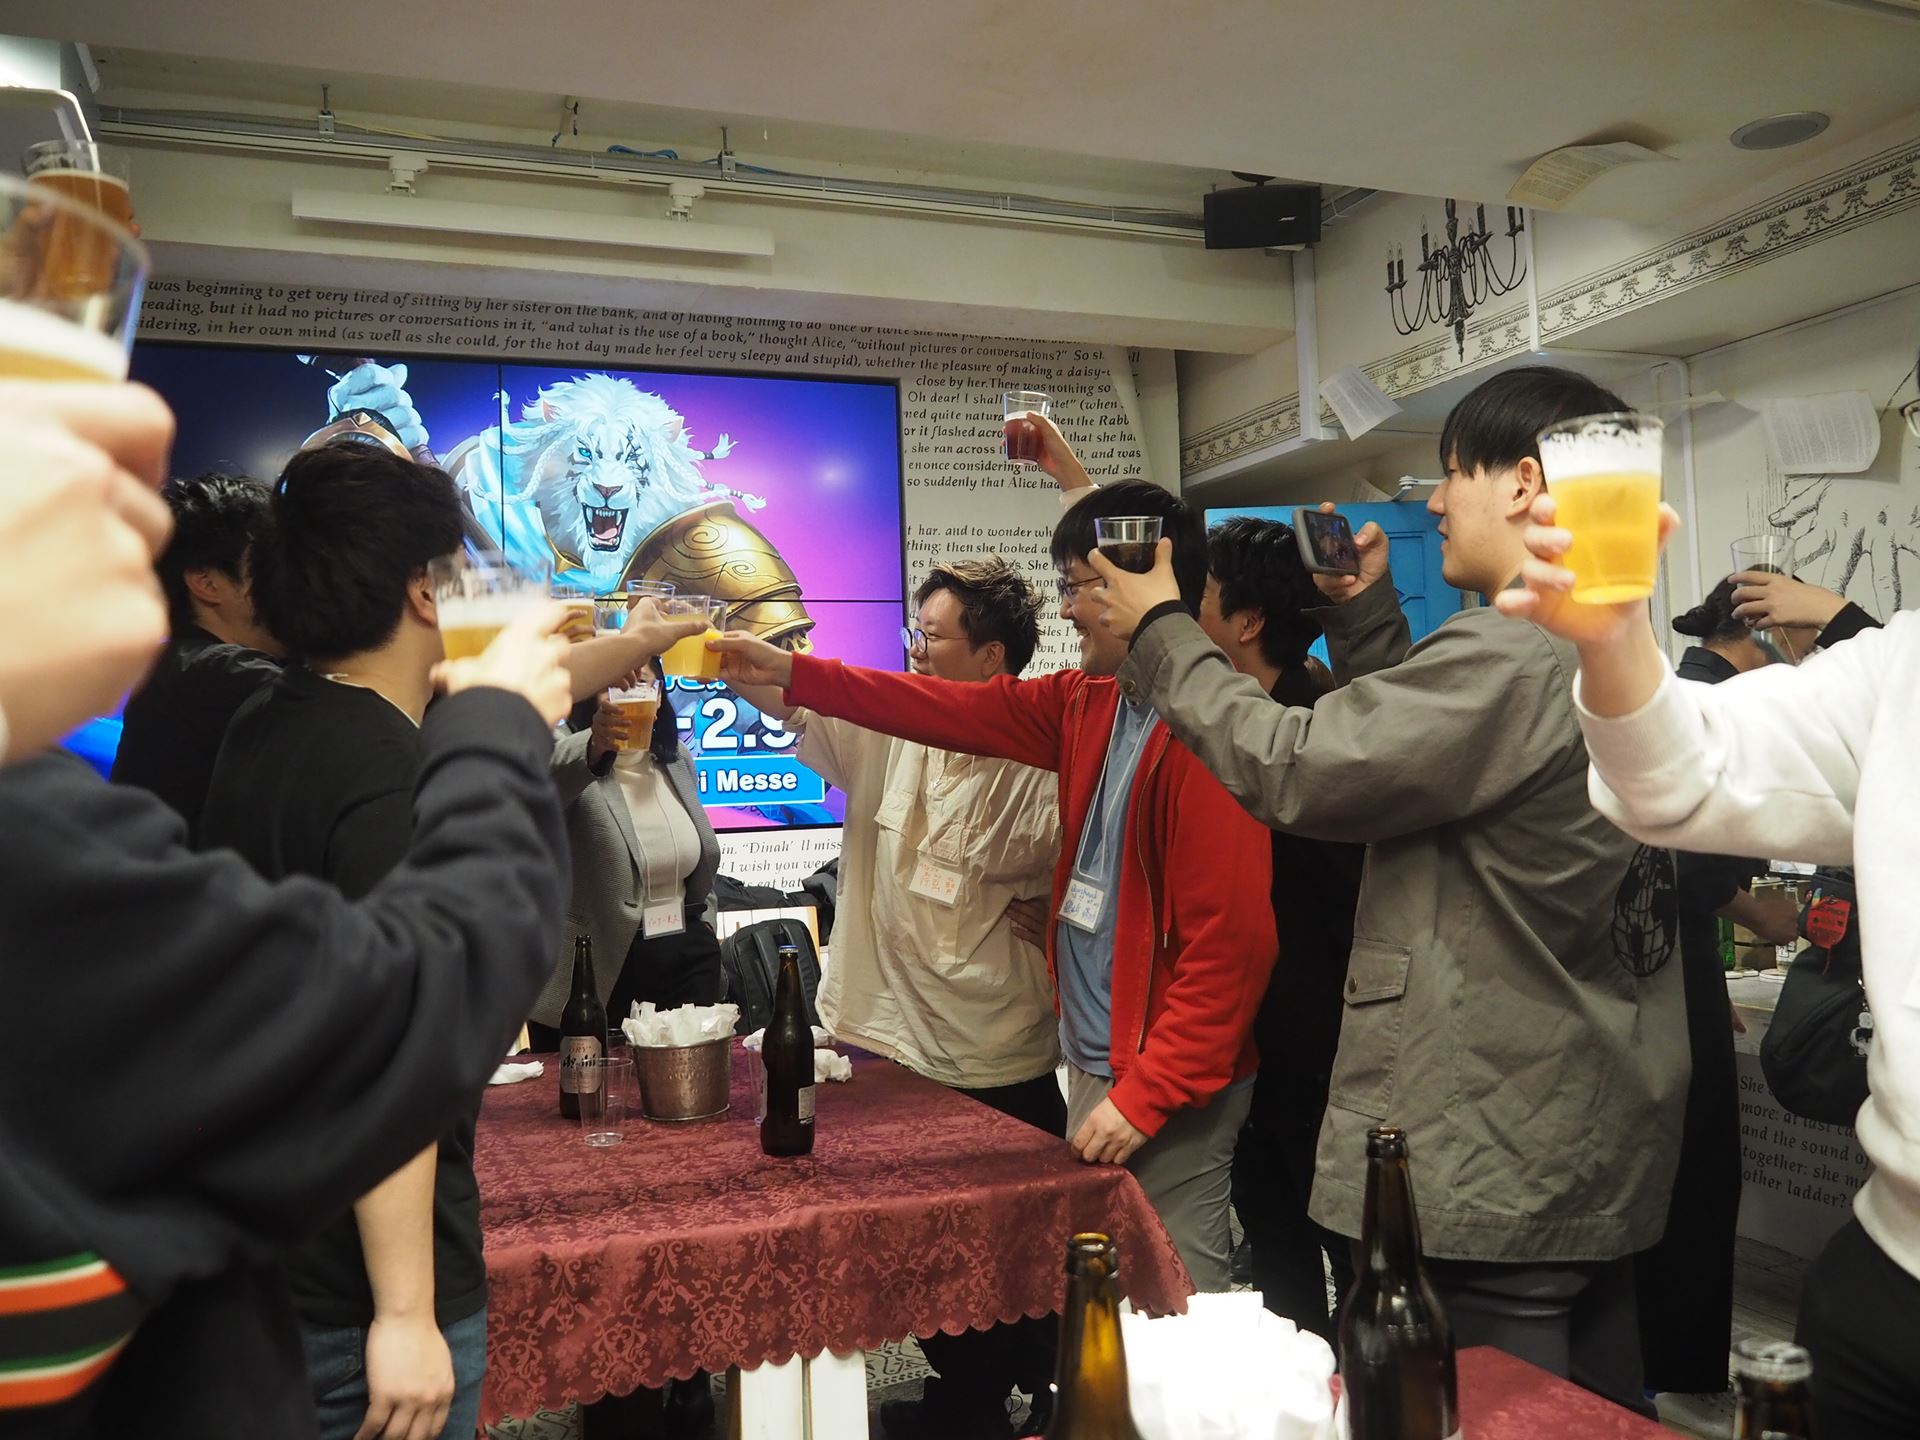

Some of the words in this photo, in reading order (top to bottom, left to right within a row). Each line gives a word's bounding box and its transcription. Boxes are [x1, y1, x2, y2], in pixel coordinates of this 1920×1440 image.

[148, 280, 181, 293] was
[186, 280, 263, 300] beginning
[268, 286, 283, 298] to
[287, 288, 312, 302] get
[316, 290, 349, 305] very
[353, 290, 389, 304] tired
[393, 293, 410, 308] of
[411, 295, 460, 312] sitting
[464, 297, 482, 313] by
[485, 298, 508, 311] her
[512, 301, 551, 314] sister
[555, 306, 572, 315] on
[576, 305, 597, 317] the
[642, 308, 667, 321] and
[209, 302, 235, 314] but
[241, 303, 253, 315] it
[258, 304, 287, 317] had
[291, 309, 309, 318] no
[314, 307, 374, 322] pictures
[379, 313, 394, 323] or
[399, 313, 499, 329] conversations
[503, 317, 517, 330] in
[579, 322, 614, 336] what
[619, 324, 630, 336] is
[634, 325, 655, 337] the
[659, 329, 680, 338] use
[683, 328, 699, 342] of
[700, 331, 708, 341] a
[759, 333, 808, 349] thought
[909, 341, 957, 357] pictures
[960, 345, 974, 355] or
[1073, 349, 1089, 360] So
[207, 320, 223, 332] in
[228, 321, 254, 334] her
[259, 325, 293, 336] own
[299, 326, 337, 339] mind
[369, 328, 401, 342] well
[405, 332, 422, 343] as
[426, 332, 451, 345] she
[503, 335, 526, 351] for
[530, 337, 552, 350] the
[556, 339, 580, 350] hot
[584, 340, 610, 357] day
[615, 342, 651, 355] made
[655, 344, 677, 356] her
[679, 345, 703, 360] feel
[708, 349, 736, 361] very
[740, 350, 781, 365] sleepy
[785, 352, 809, 364] and
[865, 356, 916, 369] whether
[920, 358, 939, 371] the
[942, 360, 992, 373] pleasure
[996, 362, 1009, 376] of
[1011, 362, 1053, 379] making
[1056, 368, 1063, 377] a
[916, 375, 946, 387] close
[949, 376, 963, 389] by
[1023, 383, 1046, 392] was
[1048, 384, 1094, 396] nothing
[1098, 385, 1111, 393] so
[908, 391, 926, 402] Oh
[930, 410, 961, 423] quite
[965, 411, 1004, 422] natura
[1077, 415, 1095, 426] the
[920, 425, 928, 436] it
[930, 425, 975, 440] flashed
[1069, 431, 1092, 442] that
[1096, 431, 1117, 443] she
[912, 442, 930, 454] she
[934, 445, 953, 454] ran
[956, 444, 995, 454] across
[1091, 448, 1114, 460] and
[1118, 449, 1141, 458] was
[924, 462, 950, 470] once
[953, 460, 1021, 475] considering
[1123, 463, 1141, 475] she
[906, 478, 920, 487] so
[924, 476, 977, 491] suddenly
[981, 476, 1004, 488] that
[1008, 476, 1037, 489] Alice
[945, 525, 968, 537] and
[971, 527, 983, 537] to
[987, 526, 1032, 538] wonder
[946, 541, 973, 553] then
[976, 542, 995, 553] she
[999, 542, 1037, 554] looked
[1028, 560, 1049, 571] She
[1037, 659, 1056, 673] for
[717, 769, 798, 792] Messe
[814, 838, 843, 851] miss
[739, 860, 770, 873] wish
[775, 863, 798, 875] you
[803, 860, 826, 869] wer
[1740, 1075, 1764, 1094] She
[1742, 1124, 1768, 1141] and
[1773, 1130, 1796, 1148] the
[1801, 1140, 1849, 1161] sound
[1813, 1164, 1839, 1183] she
[1743, 1170, 1782, 1190] other
[1787, 1180, 1847, 1208] ladder?
